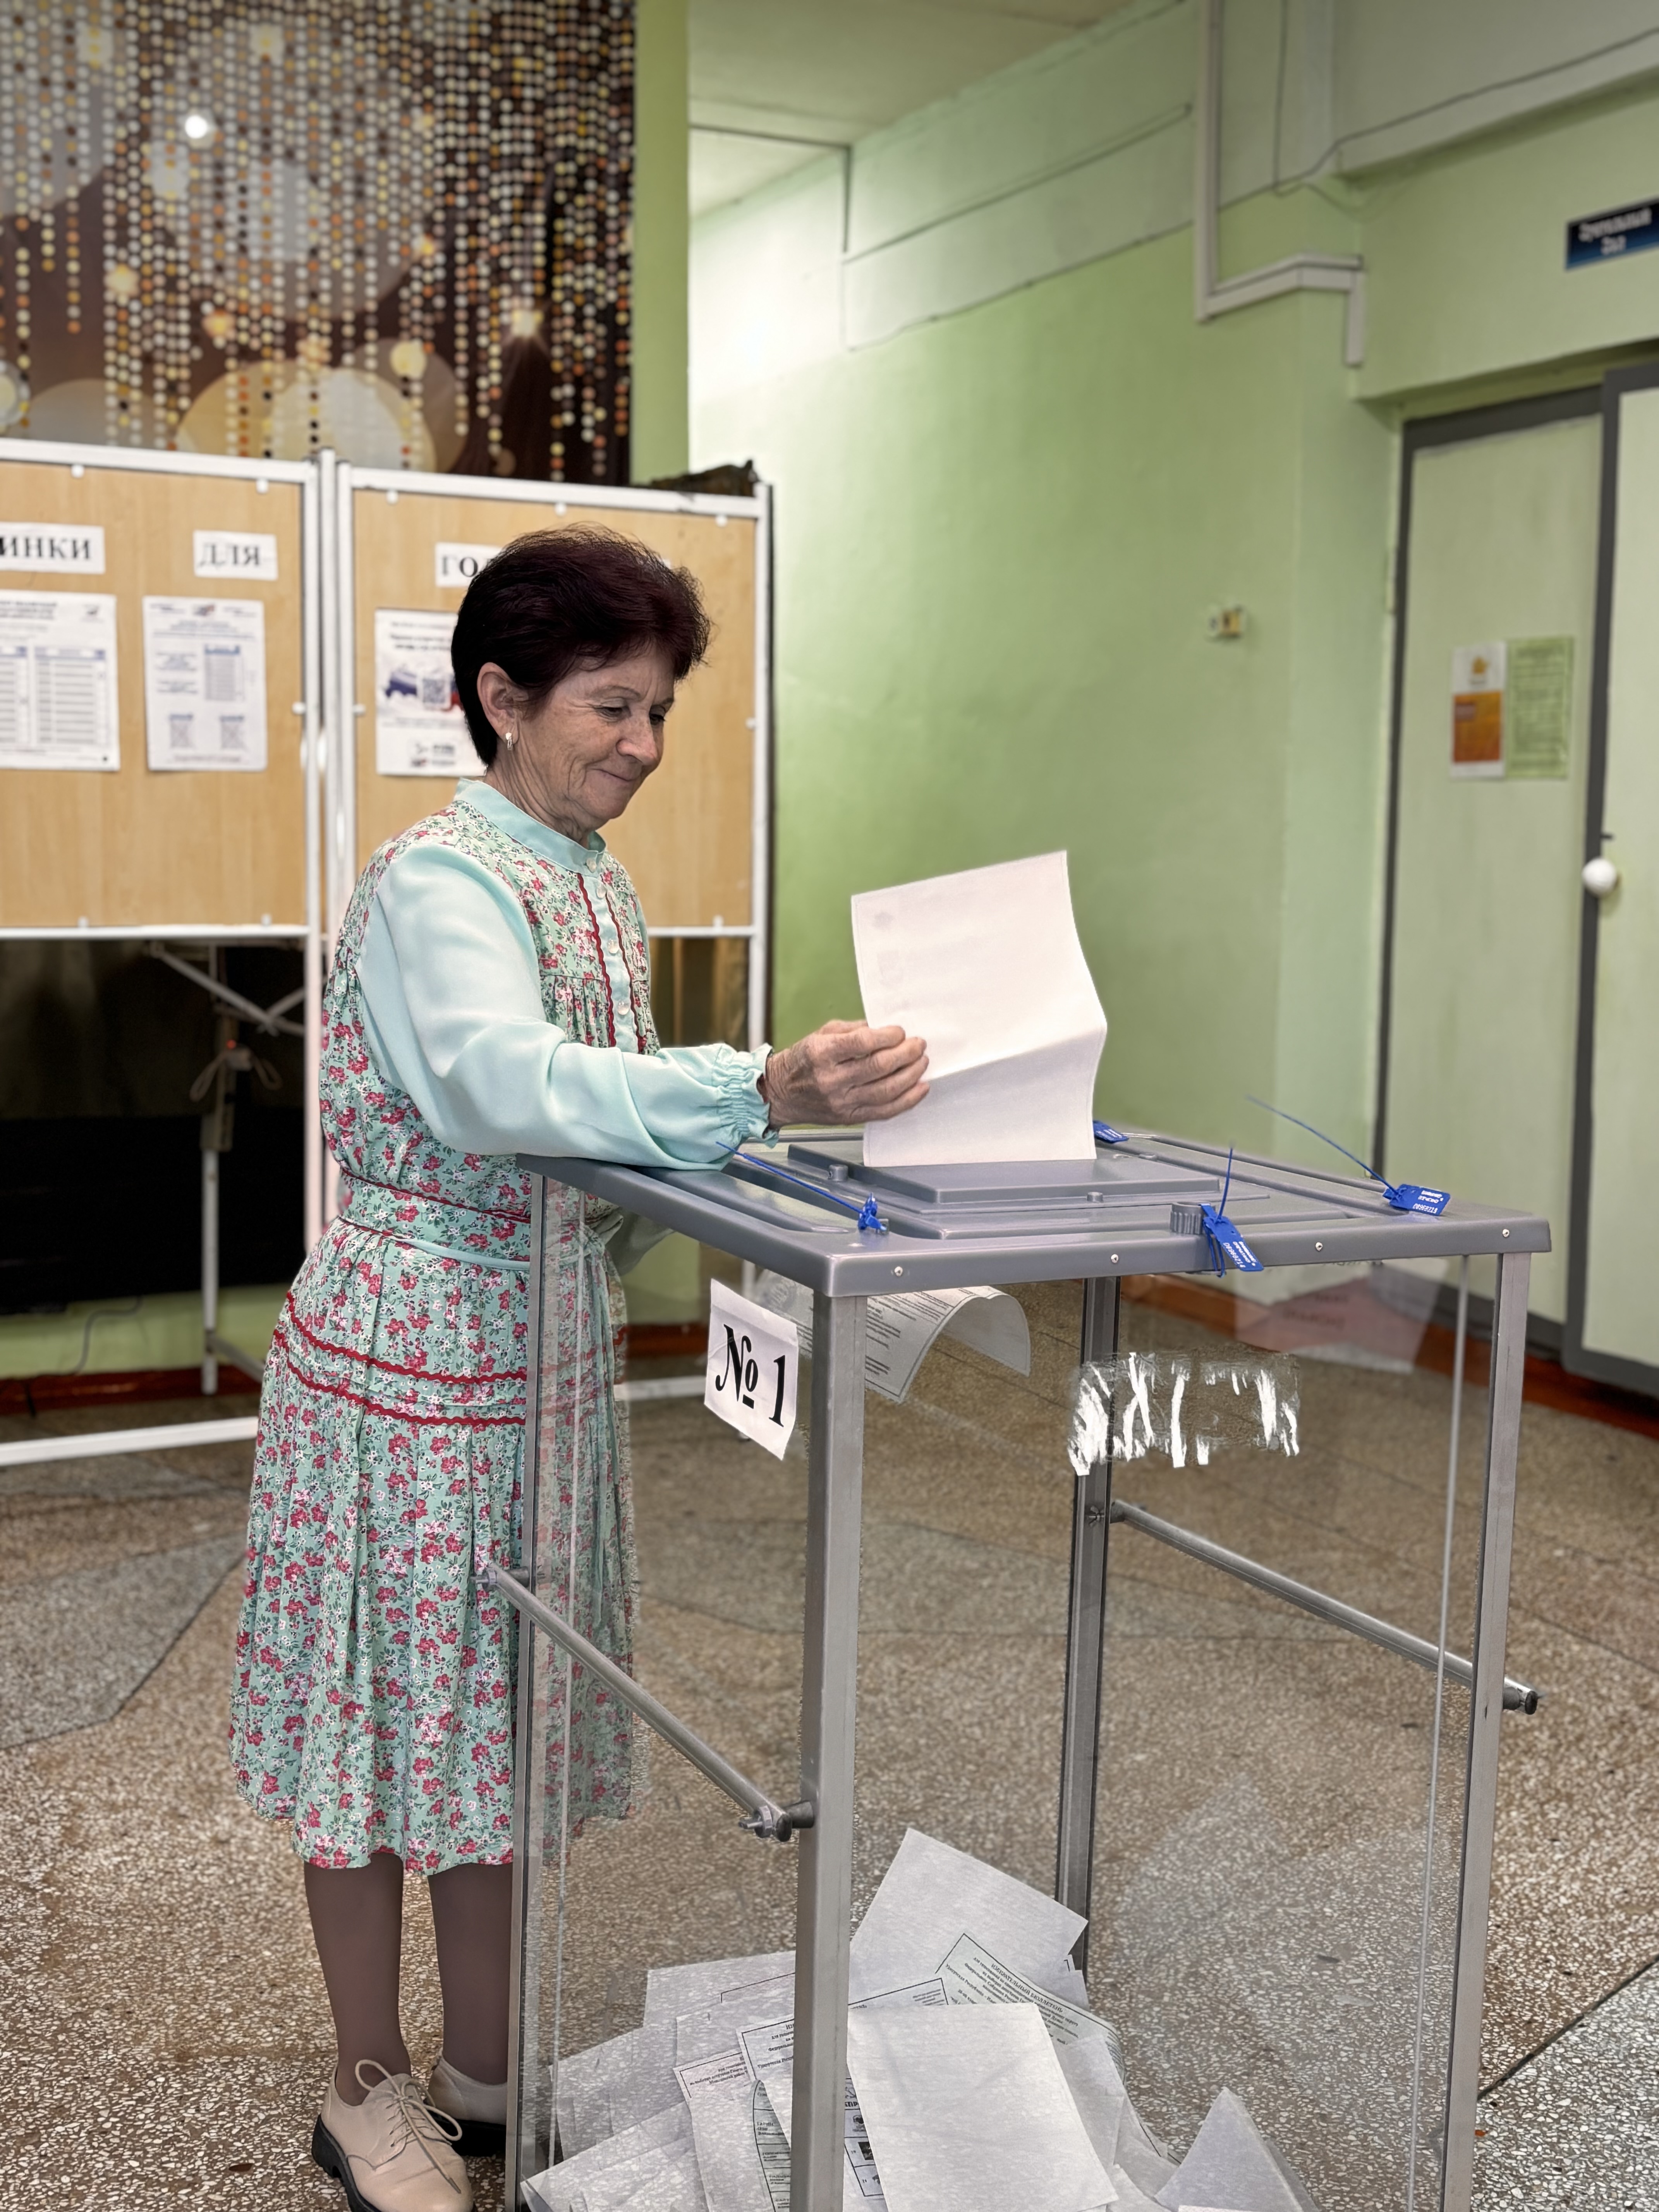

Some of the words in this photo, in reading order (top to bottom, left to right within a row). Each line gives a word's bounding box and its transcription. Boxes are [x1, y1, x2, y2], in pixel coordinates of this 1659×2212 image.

[197, 543, 259, 570] ДЛЯ
[441, 555, 492, 577] ГО
[716, 1323, 759, 1409] №
[768, 1355, 786, 1428] 1
